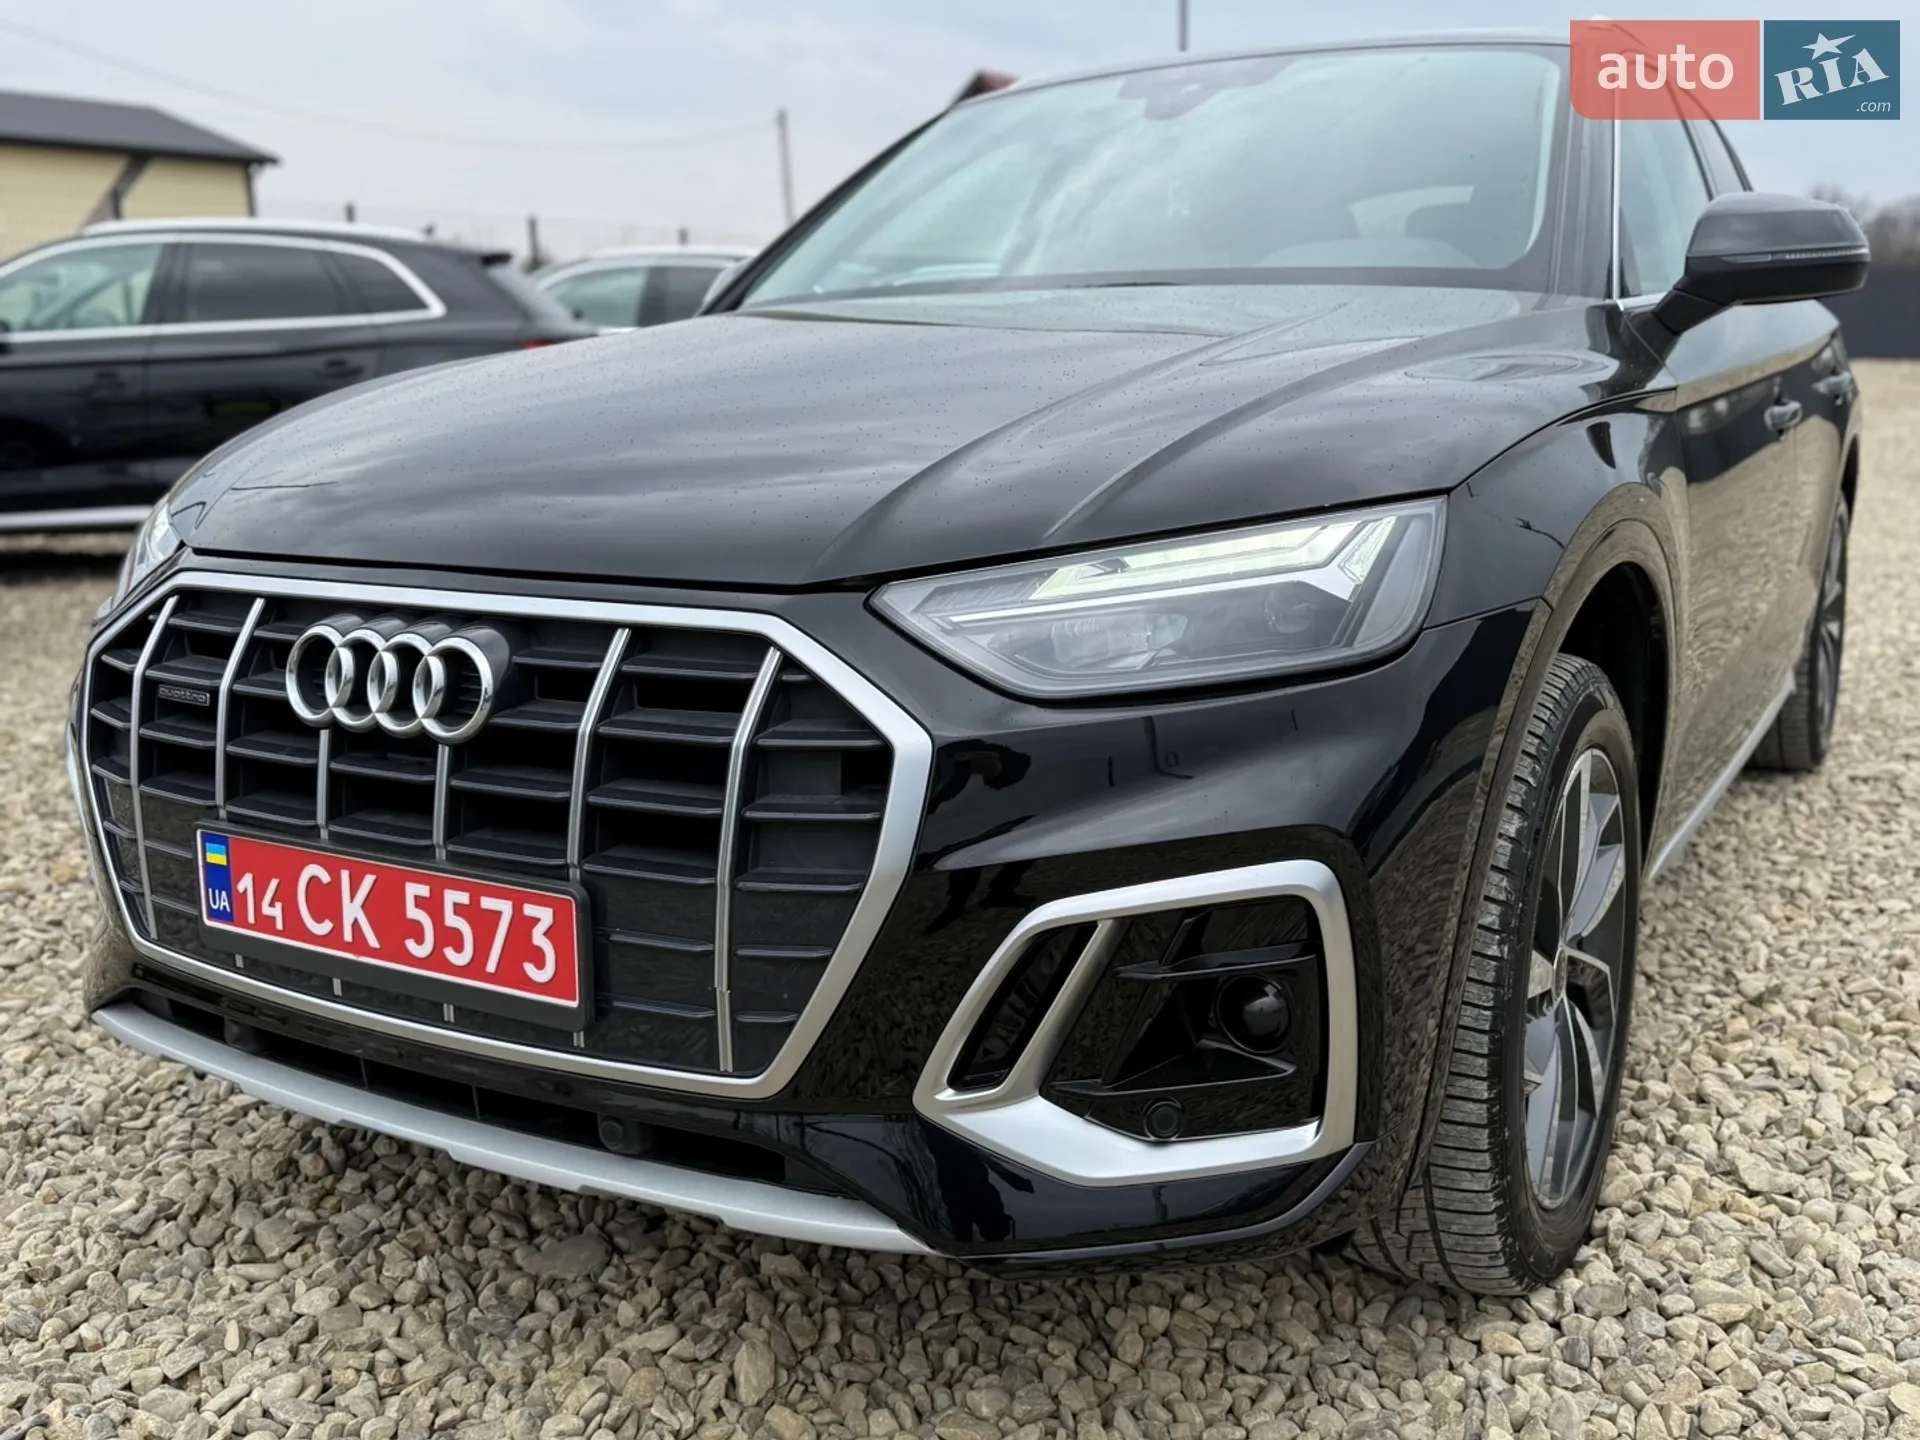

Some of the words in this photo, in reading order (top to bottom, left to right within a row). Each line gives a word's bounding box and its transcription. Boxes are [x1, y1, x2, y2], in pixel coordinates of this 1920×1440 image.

[159, 687, 207, 703] quattro
[208, 888, 231, 912] UA
[236, 872, 284, 931] 14
[296, 863, 381, 949] CK
[404, 881, 556, 984] 5573
